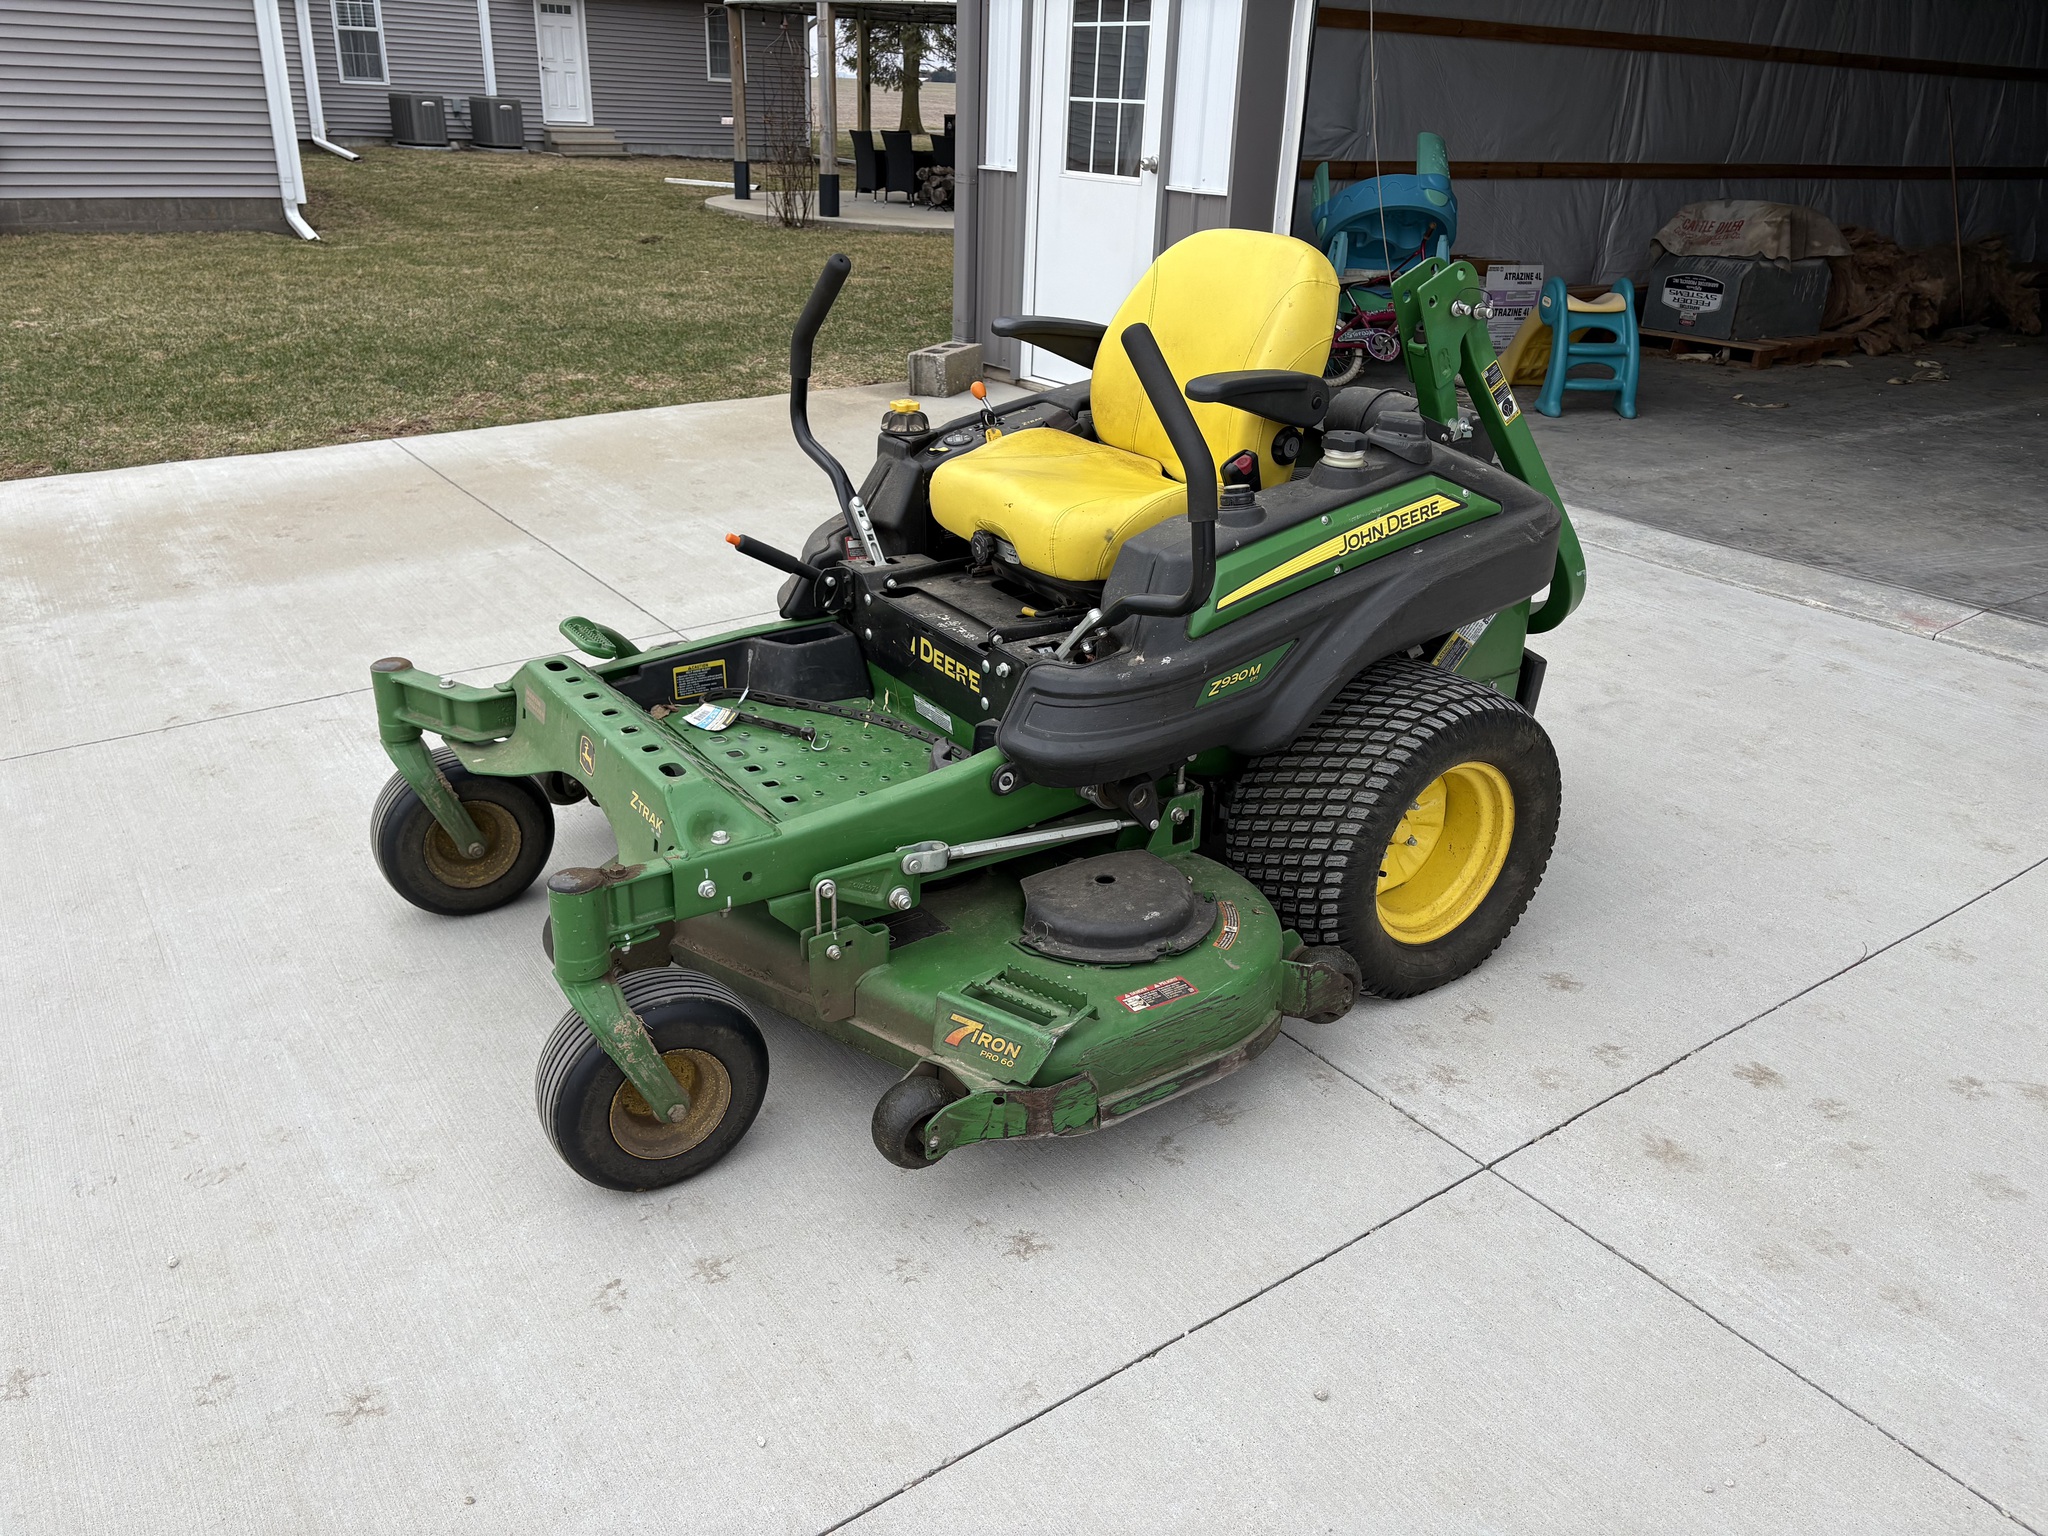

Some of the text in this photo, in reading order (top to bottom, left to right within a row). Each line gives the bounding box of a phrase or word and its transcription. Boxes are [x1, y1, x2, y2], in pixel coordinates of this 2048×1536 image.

[1504, 272, 1542, 281] ATRAZINE 4L
[1669, 290, 1717, 300] SYSTEMS
[1672, 297, 1710, 307] FEEDER
[1493, 308, 1522, 317] TRAZINE
[1338, 500, 1441, 555] JOHN DEERE
[920, 635, 981, 694] DEERE
[1207, 662, 1262, 697] Z930M
[630, 790, 664, 834] ZTRAK
[970, 1029, 1022, 1060] IRON
[979, 1049, 1015, 1069] PRO 60
